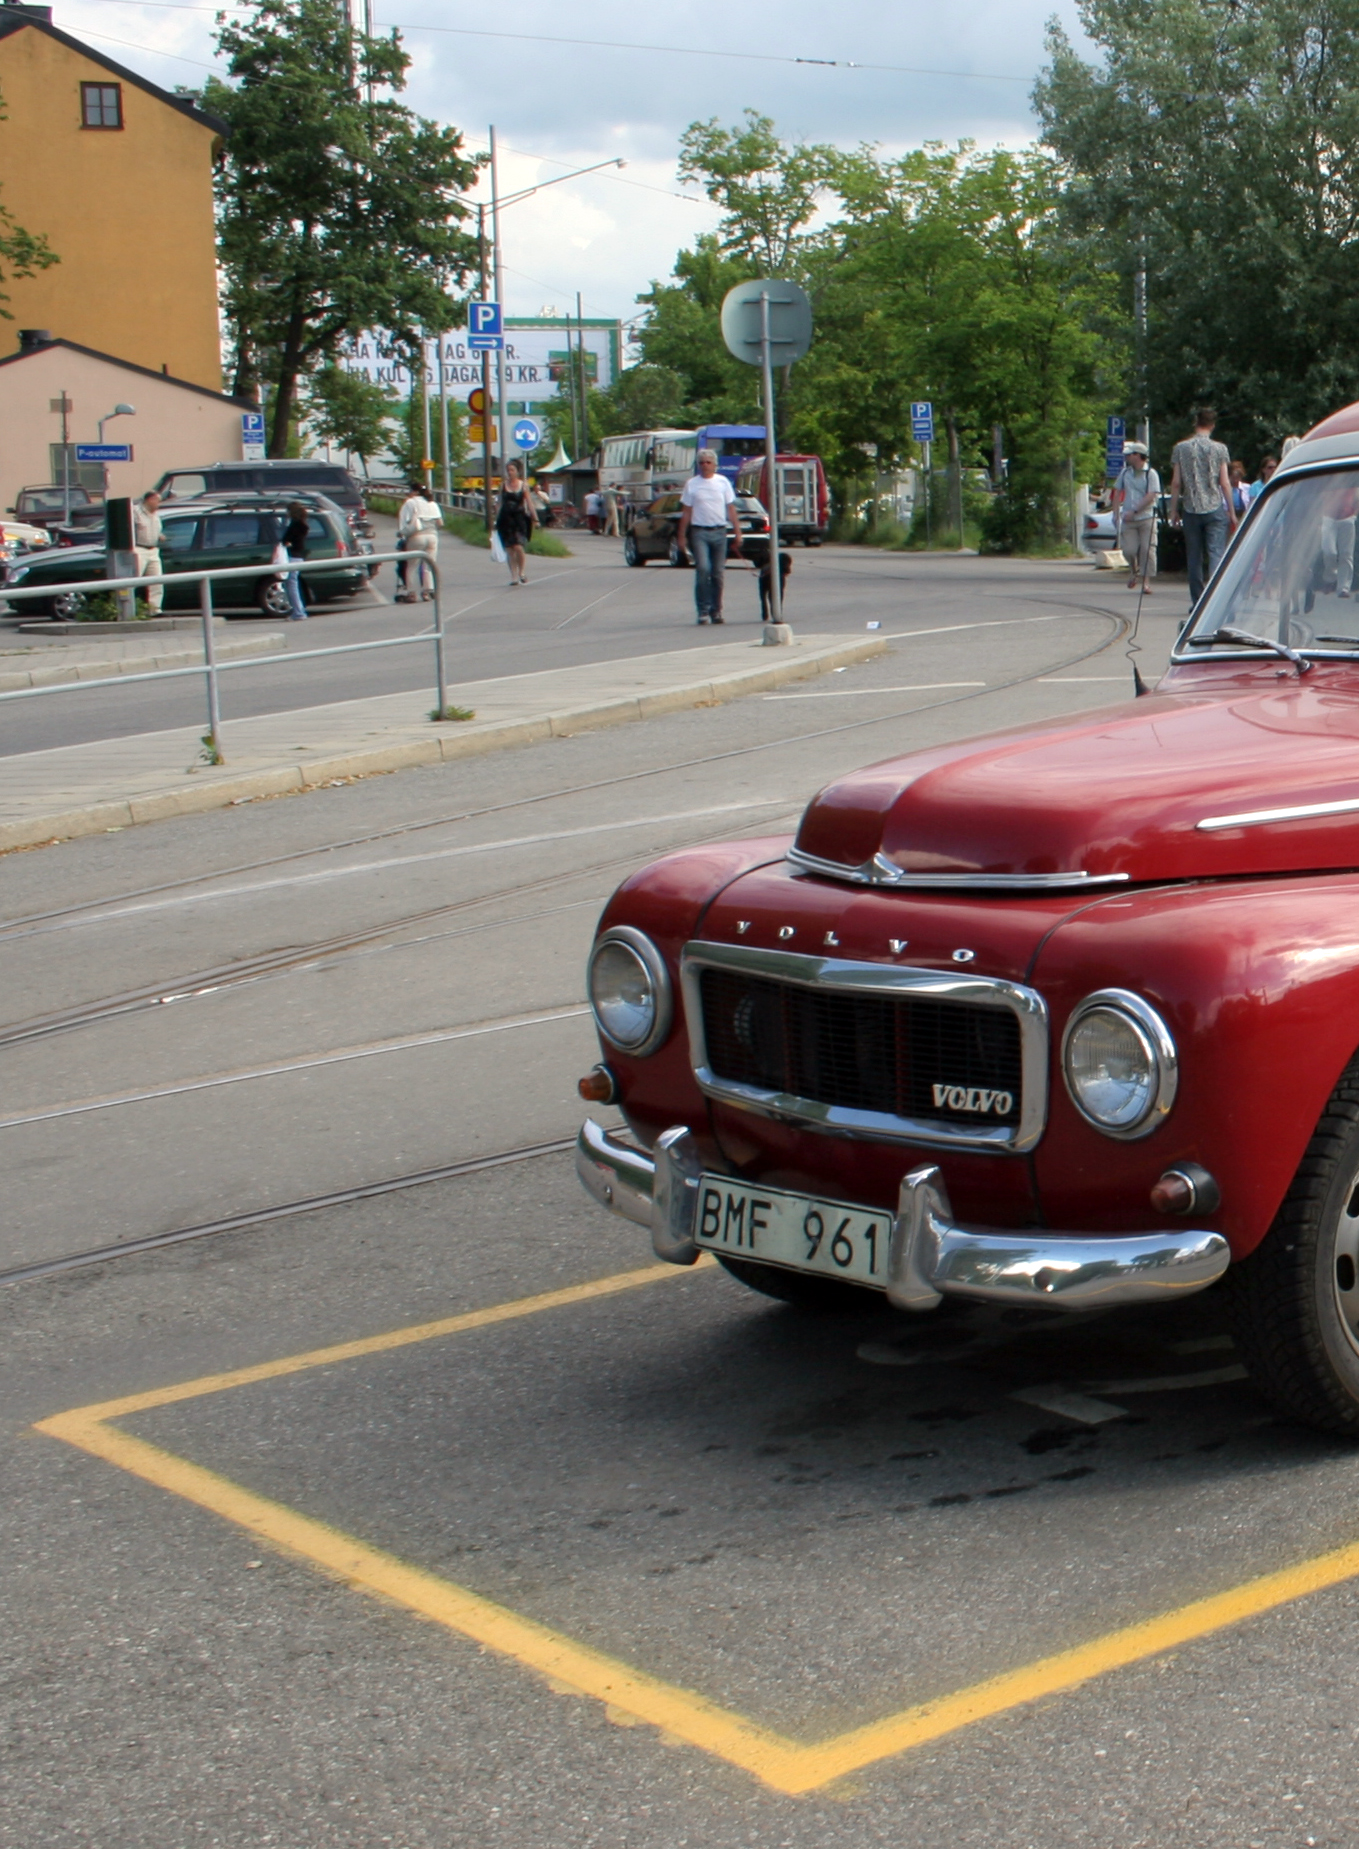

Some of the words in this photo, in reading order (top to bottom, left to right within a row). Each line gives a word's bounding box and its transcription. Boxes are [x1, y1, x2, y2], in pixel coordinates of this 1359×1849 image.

[477, 305, 495, 331] P
[376, 366, 406, 382] KUL
[519, 367, 541, 382] KR.
[917, 404, 926, 418] P
[248, 416, 259, 430] P
[1111, 417, 1121, 435] P
[736, 920, 976, 963] VOLVO
[932, 1083, 1013, 1115] VOLVO
[700, 1188, 772, 1249] BMF
[803, 1210, 878, 1275] 961
